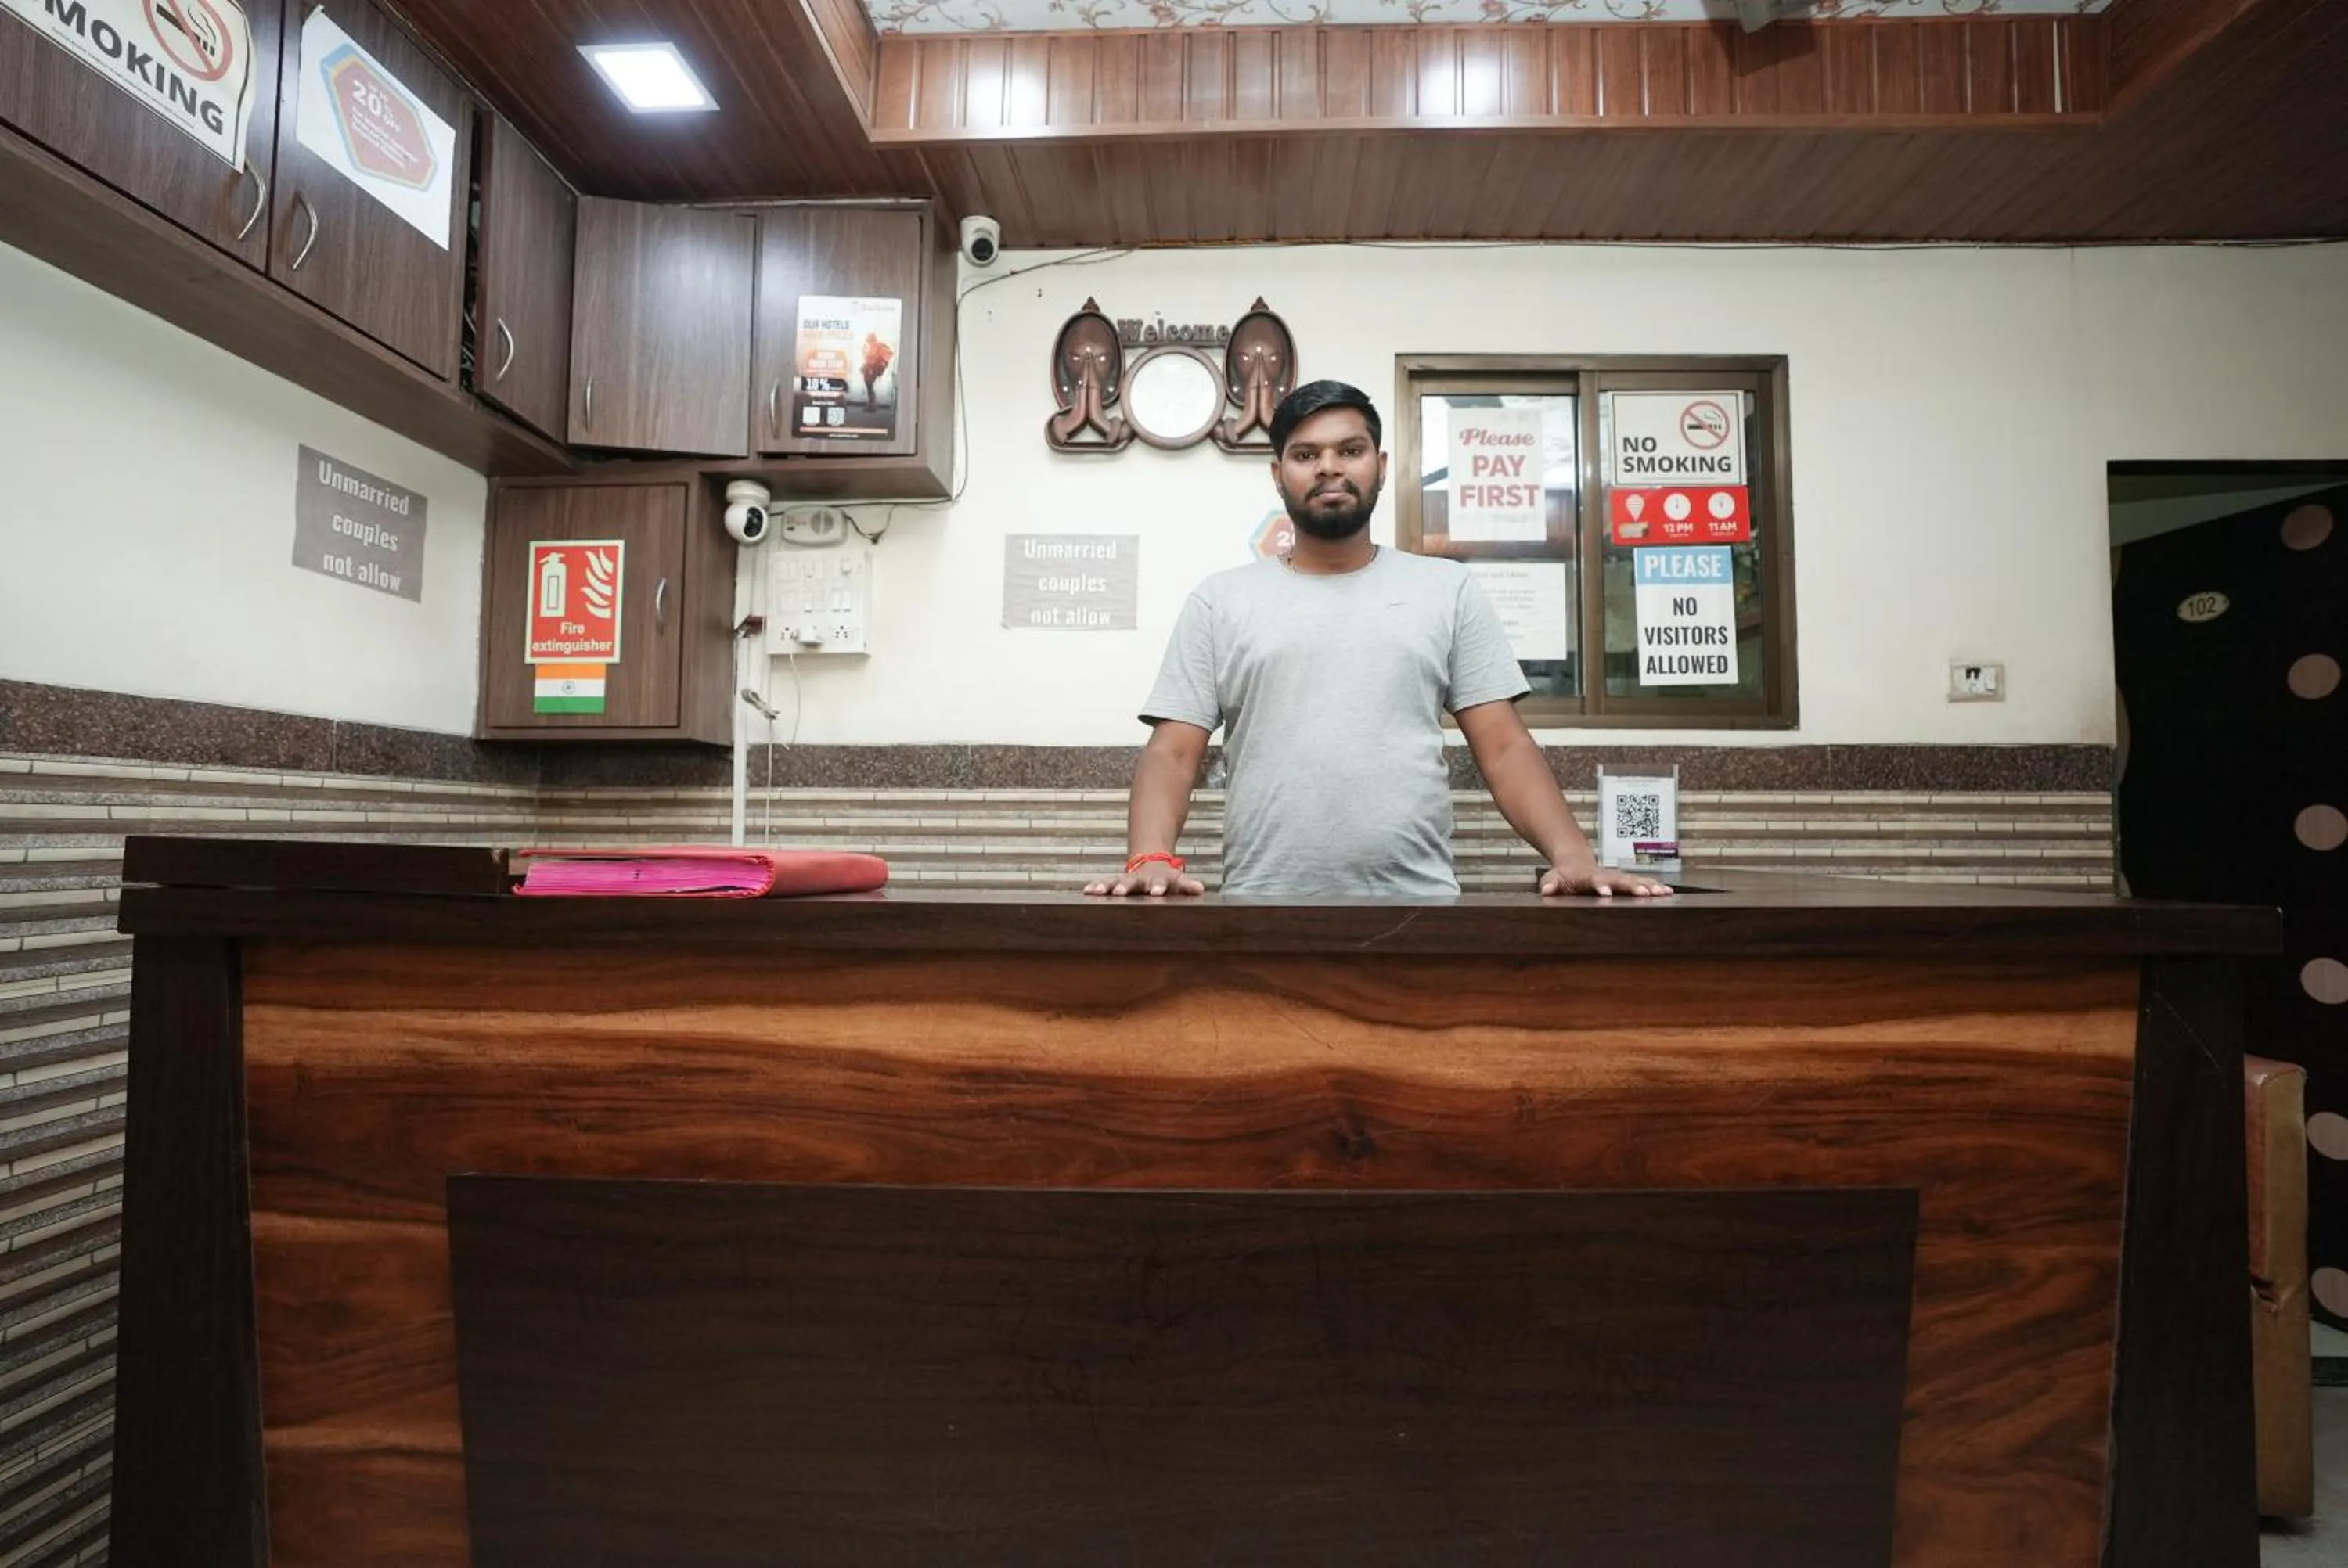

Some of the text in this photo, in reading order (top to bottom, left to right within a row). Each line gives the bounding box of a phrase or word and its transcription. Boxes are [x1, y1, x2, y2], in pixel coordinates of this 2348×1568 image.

[45, 0, 225, 135] MOKING
[1117, 318, 1231, 342] Welcome
[1459, 427, 1536, 446] Please
[1622, 436, 1657, 453] NO
[1472, 455, 1526, 477] PAY
[1622, 455, 1732, 473] SMOKING
[319, 459, 409, 516] Unmarried
[1460, 484, 1540, 508] FIRST
[332, 514, 398, 552] couples
[1025, 538, 1117, 559] Unmarried
[323, 552, 402, 592] not allow
[1644, 554, 1722, 578] PLEASE
[1038, 573, 1107, 595] couples
[1031, 606, 1111, 625] not allow
[1673, 597, 1698, 616] NO
[2188, 596, 2217, 617] 102
[560, 622, 585, 635] Fire
[1644, 626, 1728, 646] VISITORS
[532, 638, 613, 654] extinguisher
[1646, 655, 1728, 674] ALLOWED
